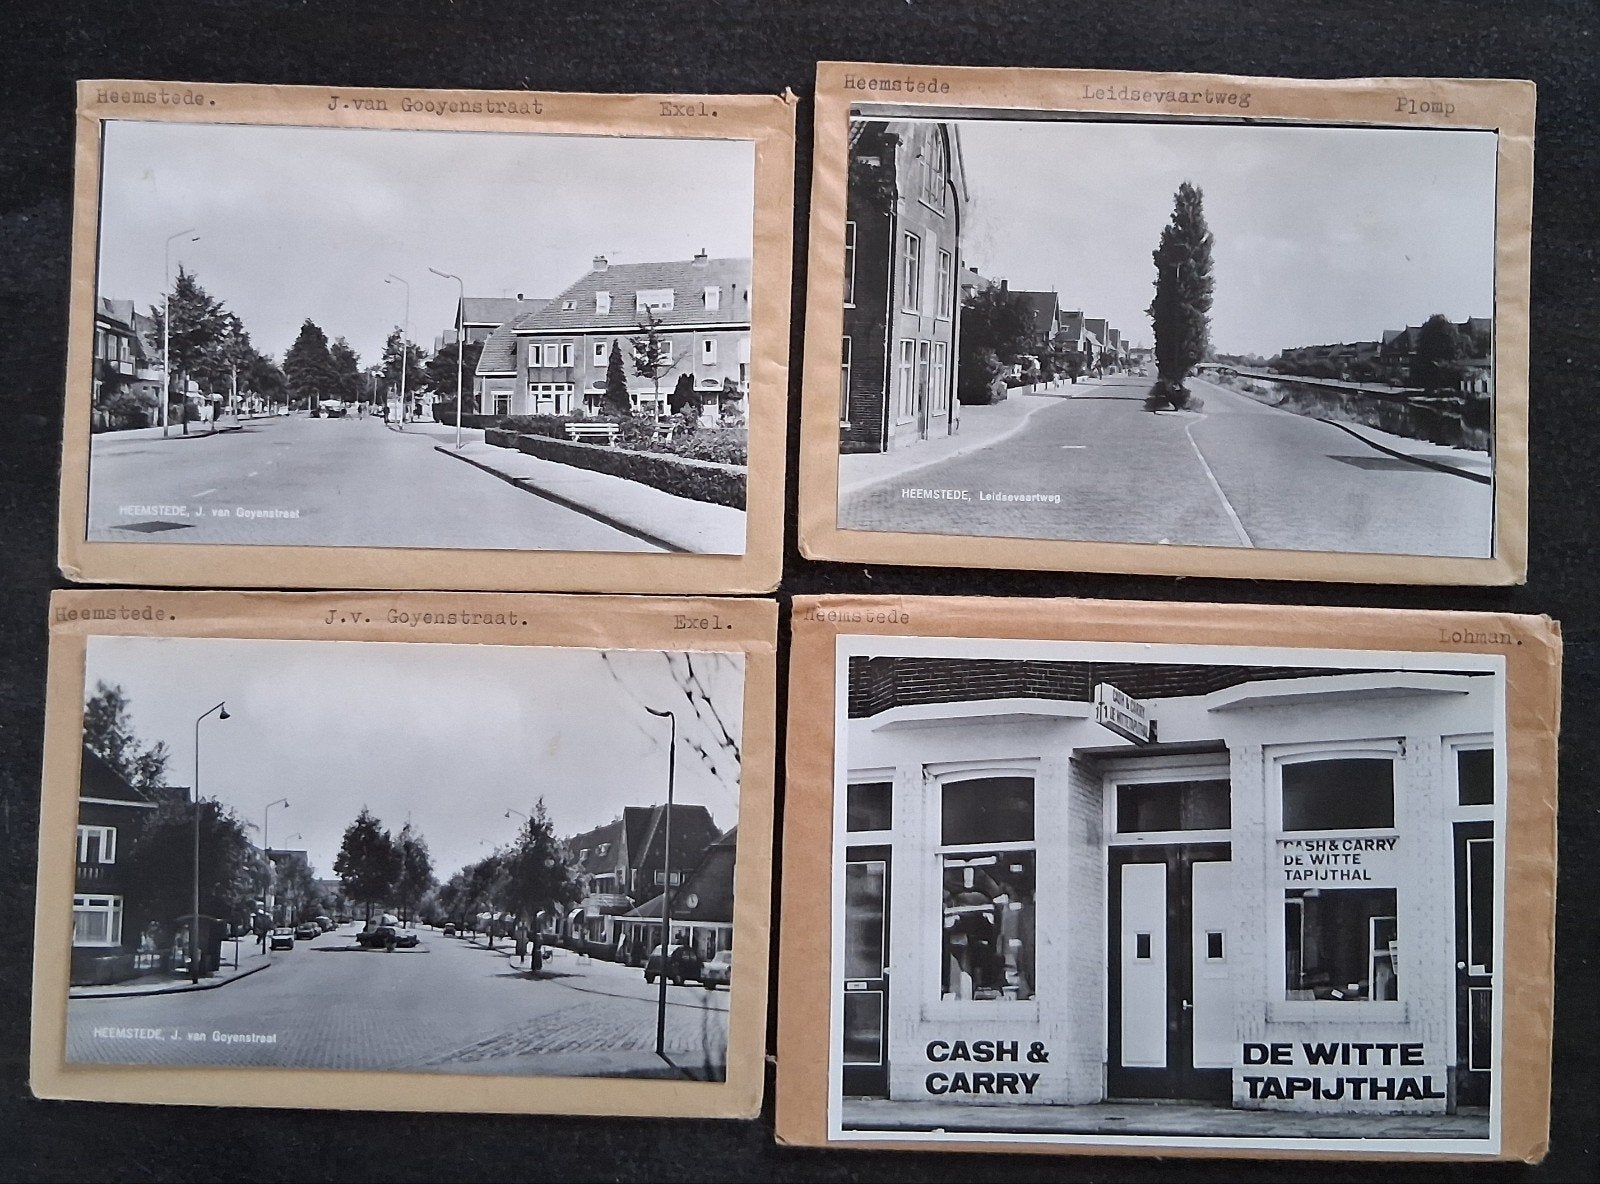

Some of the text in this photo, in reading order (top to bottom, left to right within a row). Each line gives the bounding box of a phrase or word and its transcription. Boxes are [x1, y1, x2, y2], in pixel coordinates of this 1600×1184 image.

[843, 75, 950, 94] Heemstede
[95, 88, 217, 107] Heemstede.
[1082, 85, 1252, 107] Leidsevaartweg
[327, 95, 543, 116] J.van Gooyenstraat
[659, 101, 719, 118] Exel.
[1395, 97, 1456, 117] Plomp
[901, 488, 972, 502] HEEMSTEDE,
[119, 505, 190, 518] HEEMSTEDE,
[195, 506, 206, 517] J.
[55, 606, 177, 622] Heemstede.
[325, 609, 529, 628] J.v. Goyenstraat.
[673, 614, 733, 630] Exel.
[803, 607, 910, 624] Heemstede
[1438, 628, 1523, 646] Lohman.
[1283, 852, 1361, 866] DE WITTE
[1285, 869, 1372, 881] TAPIJTHAL
[93, 1026, 166, 1041] HEEMSTEDE,
[170, 1029, 182, 1041] J.
[926, 1040, 1050, 1063] CASH &
[1243, 1042, 1425, 1066] DE WITTE
[925, 1072, 1041, 1094] CARRY
[1243, 1075, 1446, 1101] TAPIJTHAL
